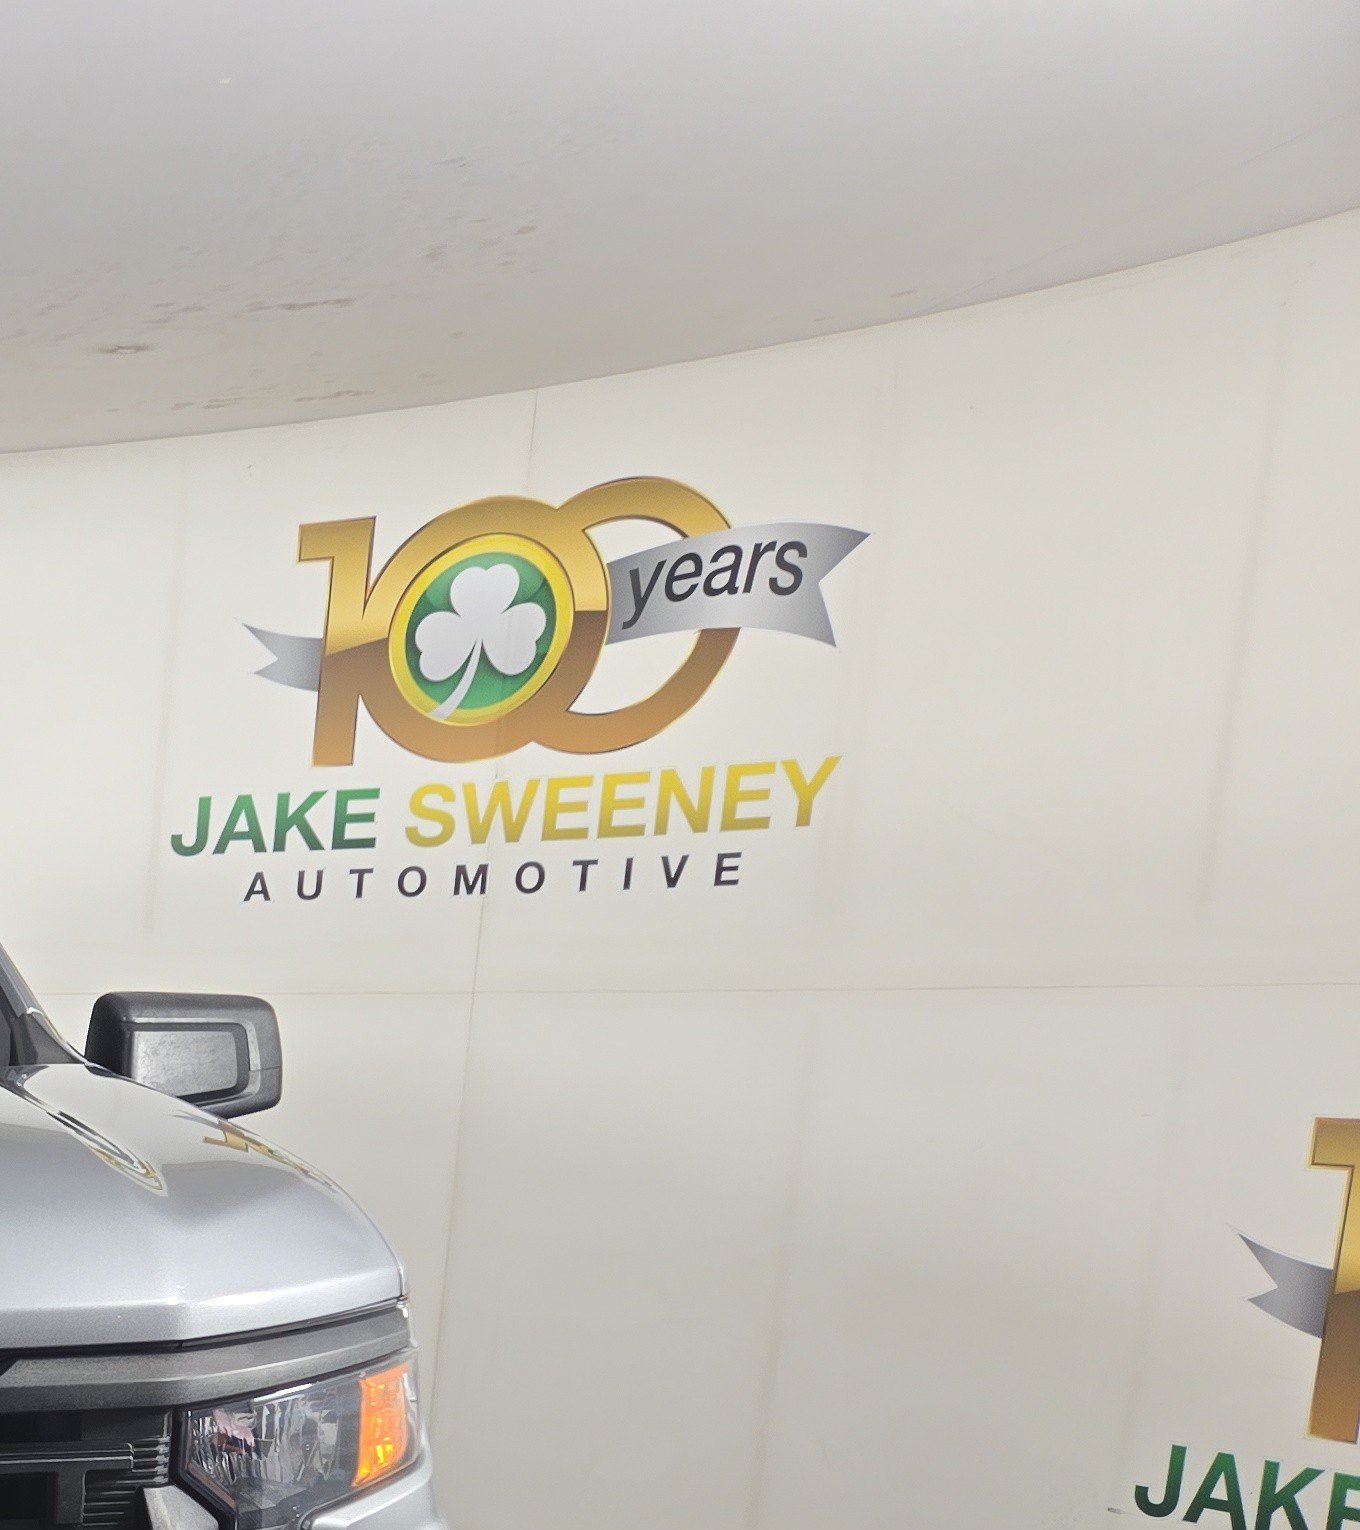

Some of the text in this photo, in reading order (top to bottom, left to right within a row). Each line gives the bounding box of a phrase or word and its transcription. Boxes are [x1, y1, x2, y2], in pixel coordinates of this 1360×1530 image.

[297, 476, 742, 767] 100
[621, 539, 808, 630] years
[170, 755, 842, 857] JAKE SWEENEY
[243, 851, 744, 902] AUTOMOTIVE
